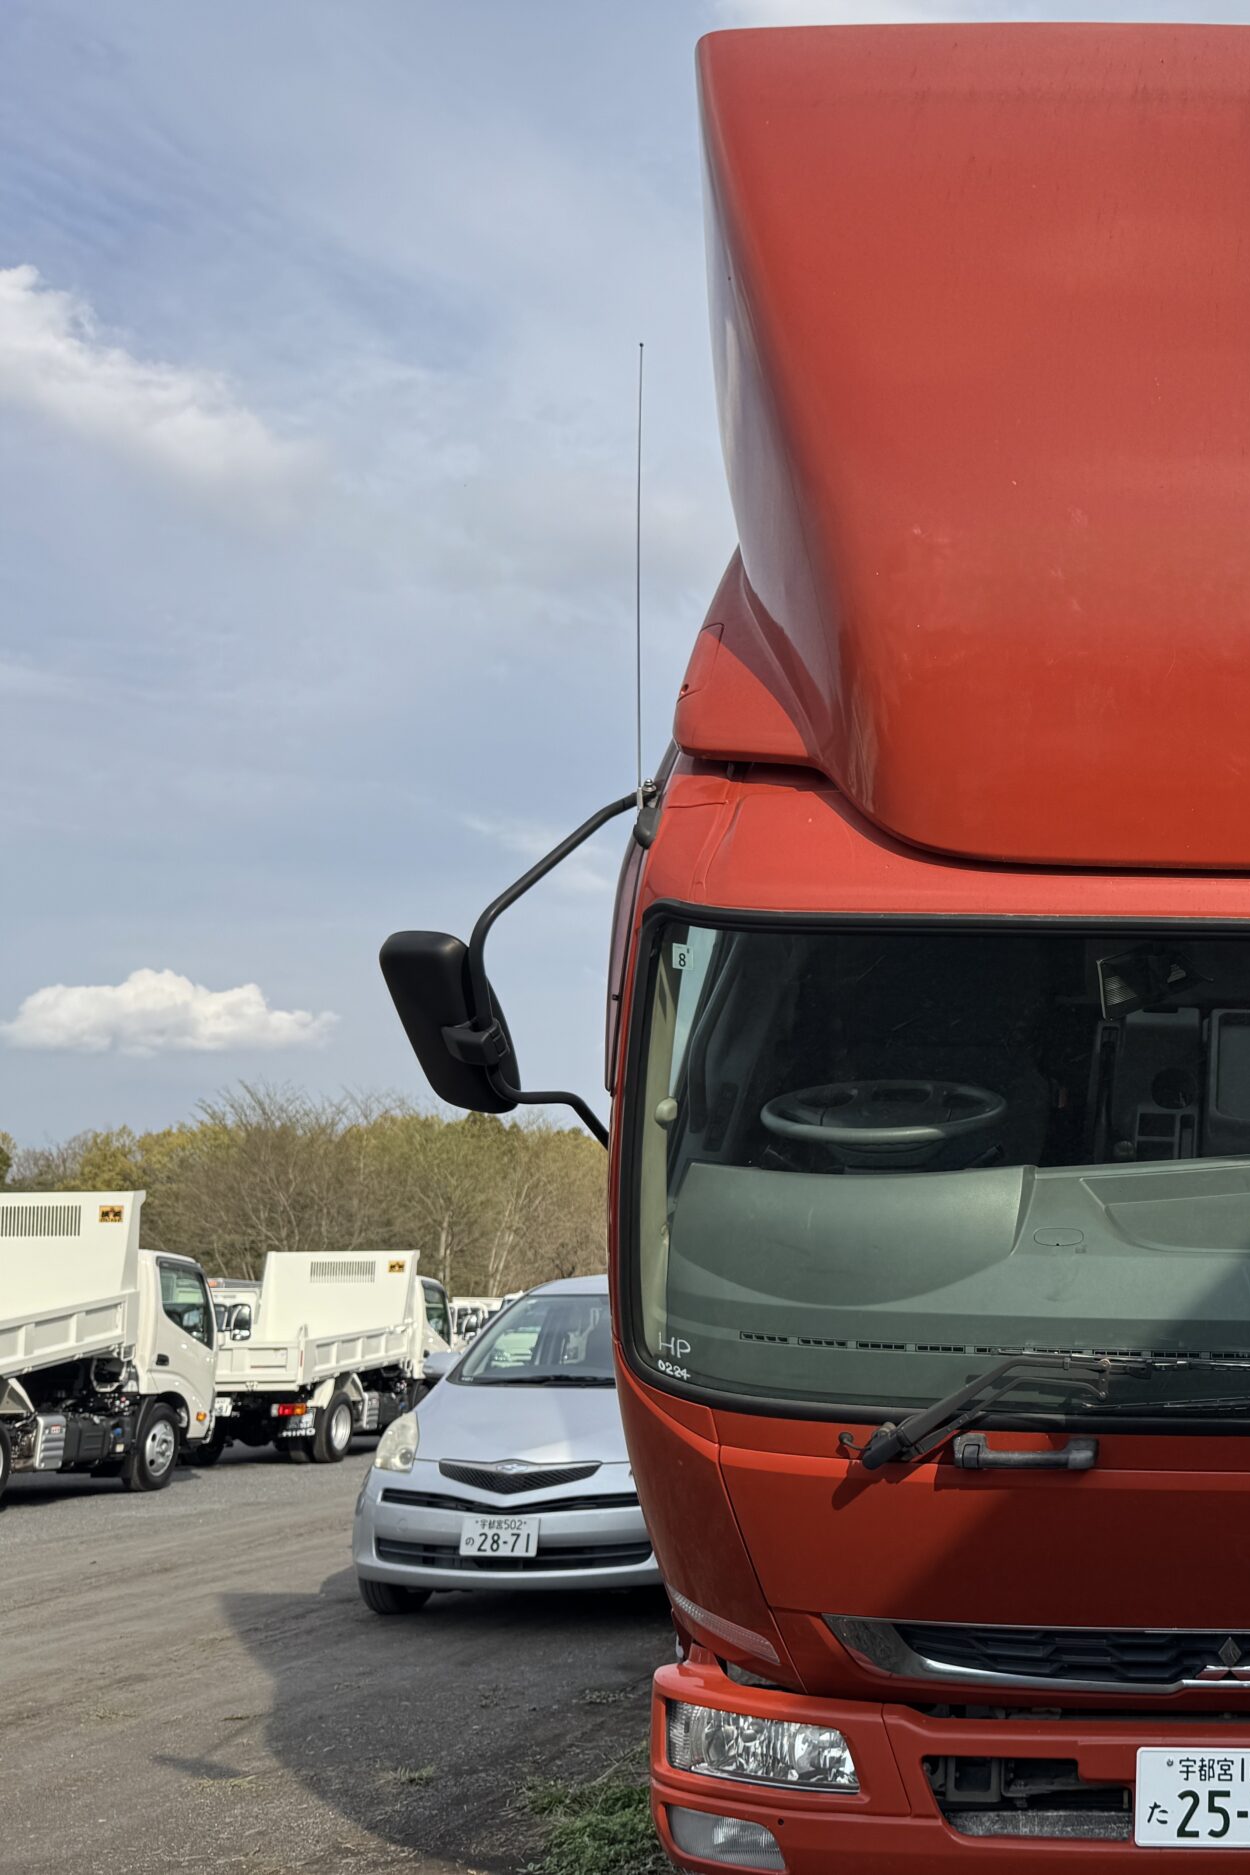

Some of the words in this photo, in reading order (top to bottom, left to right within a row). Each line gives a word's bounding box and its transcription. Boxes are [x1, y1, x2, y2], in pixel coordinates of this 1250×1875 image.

[678, 952, 687, 968] 8
[658, 1331, 691, 1359] HP
[657, 1359, 692, 1381] 0224
[465, 1536, 475, 1547] の
[477, 1532, 531, 1553] 28-71
[1147, 1801, 1169, 1825] た
